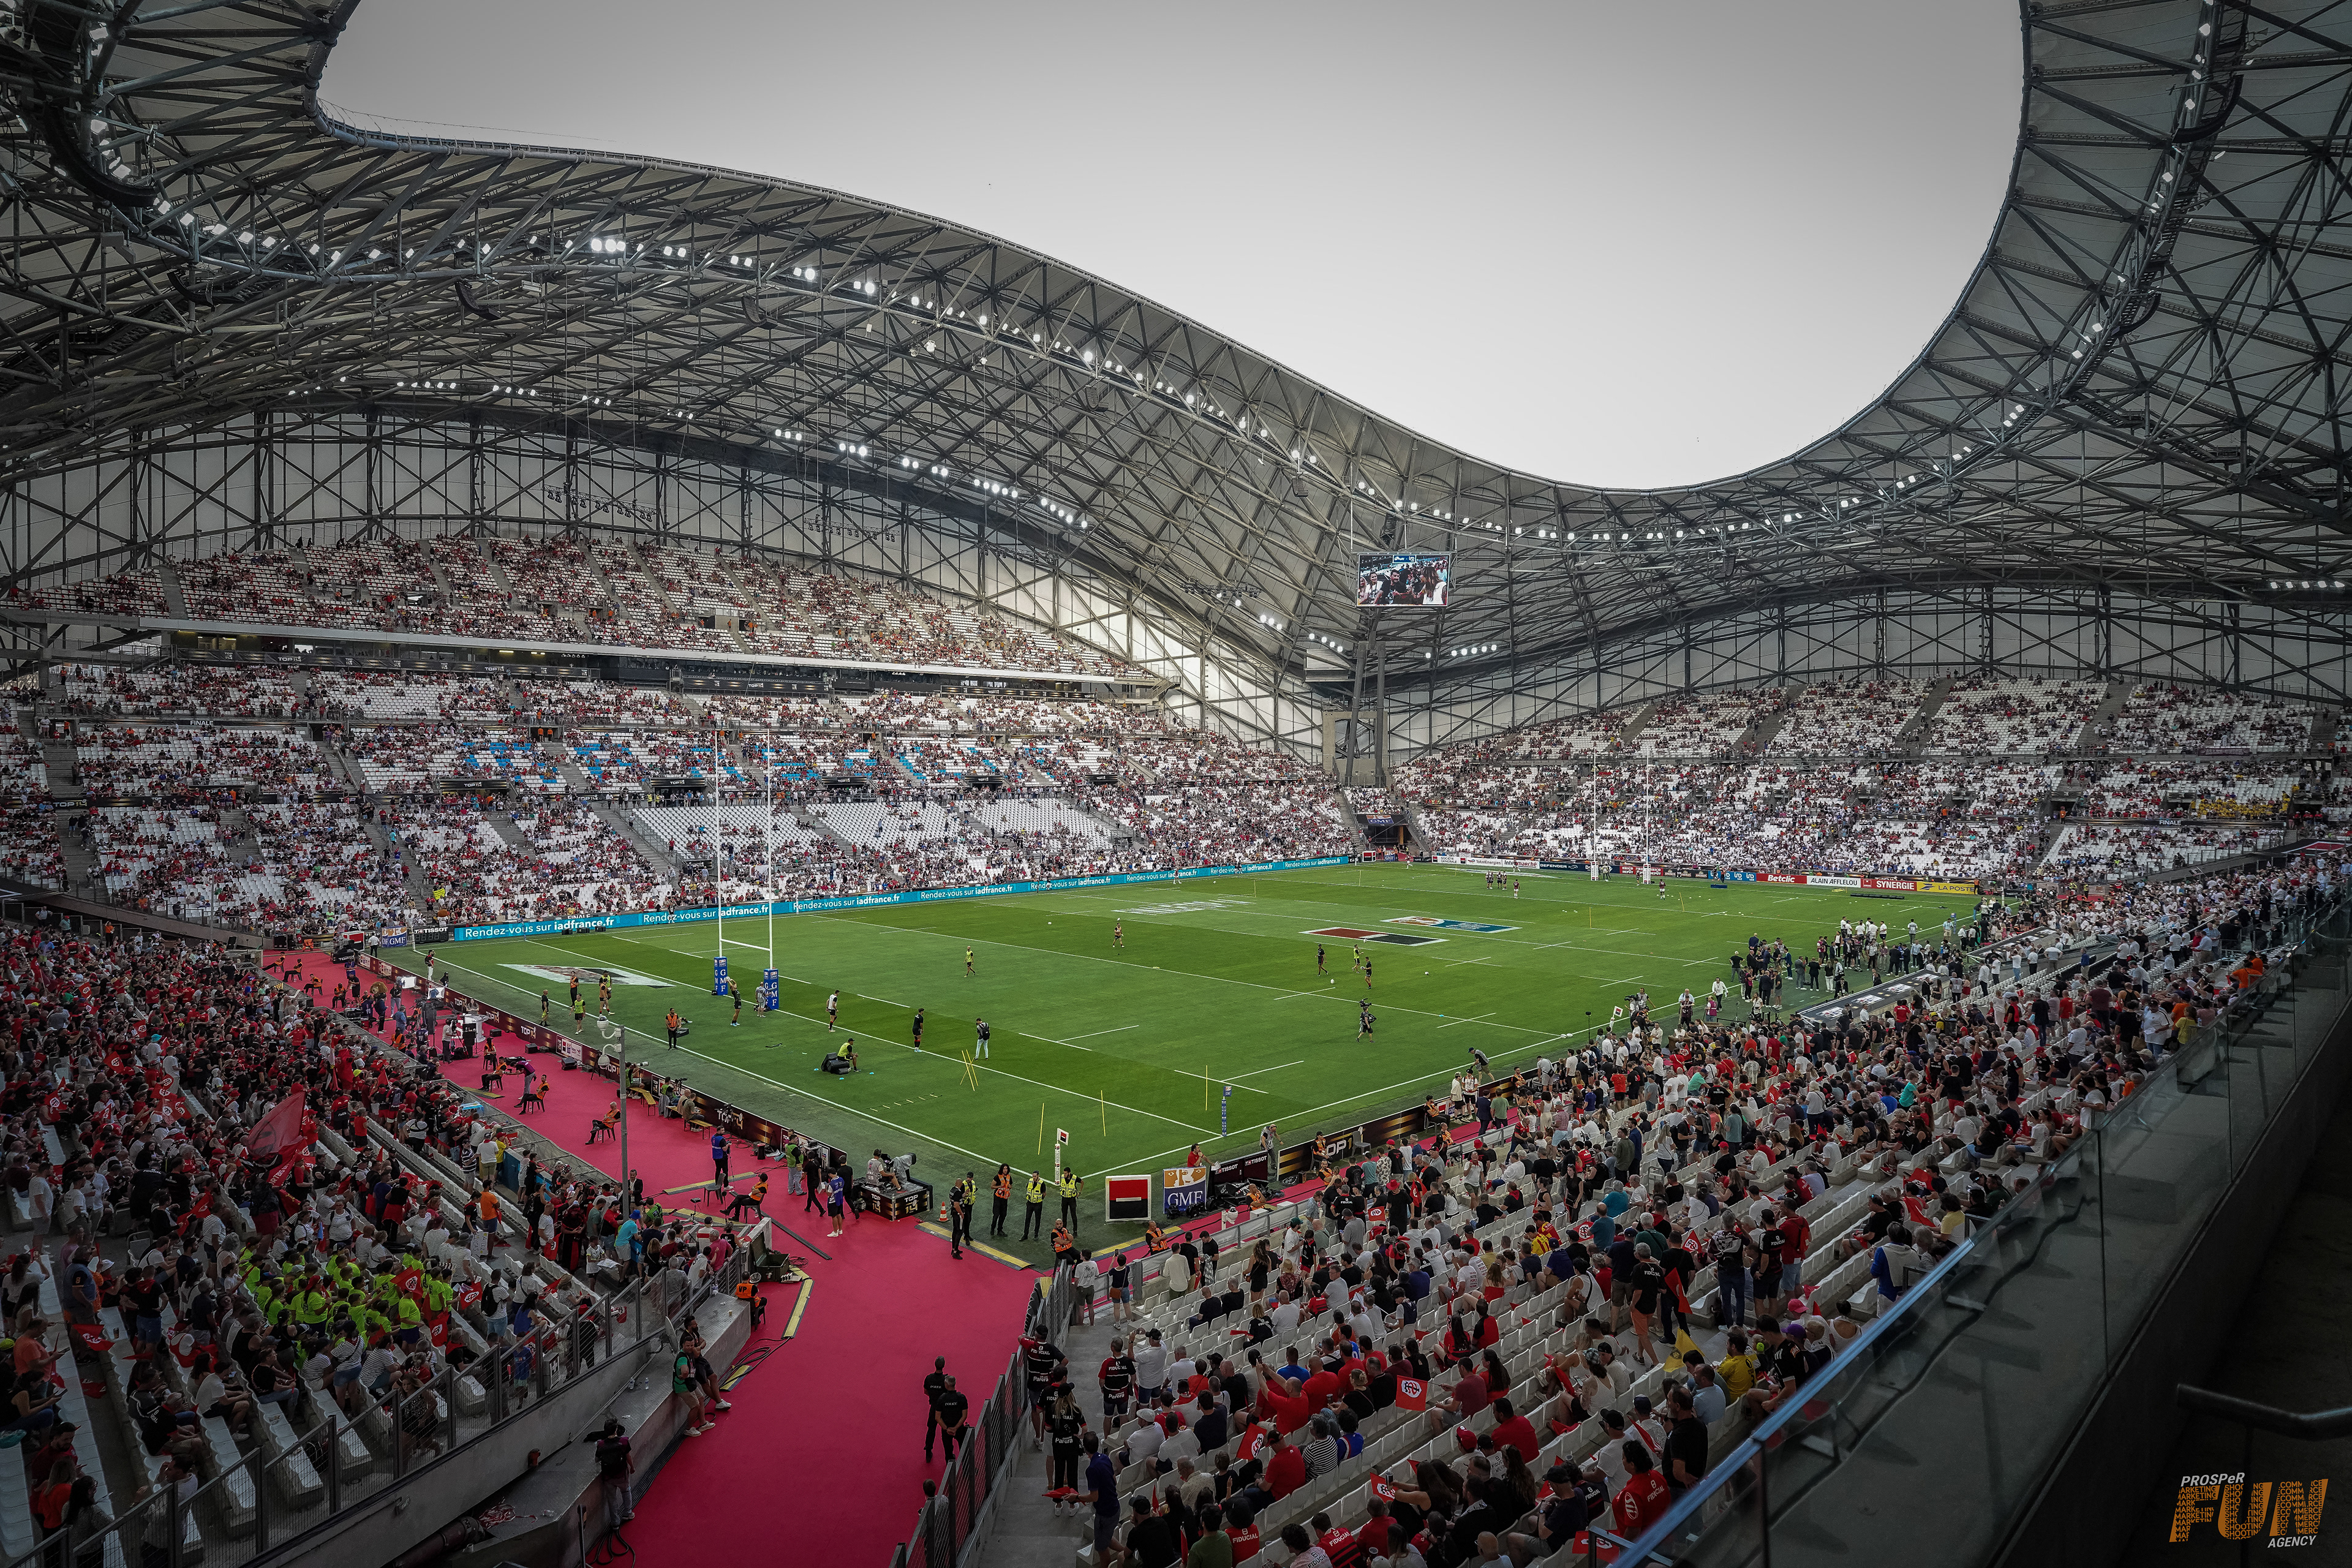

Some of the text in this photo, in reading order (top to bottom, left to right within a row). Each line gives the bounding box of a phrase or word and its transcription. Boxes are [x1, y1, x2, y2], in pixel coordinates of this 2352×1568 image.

[53, 798, 88, 807] TOP14
[1168, 869, 1197, 878] iadrance.fr
[1767, 874, 1795, 883] Betclic
[1031, 881, 1067, 890] Rendz-vous
[1078, 877, 1111, 886] iadfrance.fr
[1876, 880, 1915, 890] SYNERGIE
[921, 890, 963, 899] Rendez-vous
[975, 885, 1012, 895] iadfrance.fr
[793, 899, 842, 911] Rendez-vous
[857, 894, 900, 905] iadfrance.fr
[643, 911, 700, 923] Rendez-vous
[720, 905, 769, 917] adfrance.fr
[466, 925, 533, 938] Rendez-vous
[554, 917, 614, 930] iadfrance.fr
[486, 1011, 500, 1023] TOP14
[521, 1026, 537, 1039] TOP14
[1251, 1155, 1267, 1164] TISSOT
[1222, 1164, 1238, 1173] TISSOT
[1167, 1191, 1203, 1207] GMF
[872, 1202, 880, 1213] 14
[905, 1202, 918, 1214] 14
[1648, 1485, 1665, 1501] FIDUCIAL
[1232, 1533, 1258, 1544] FIDUCIAL
